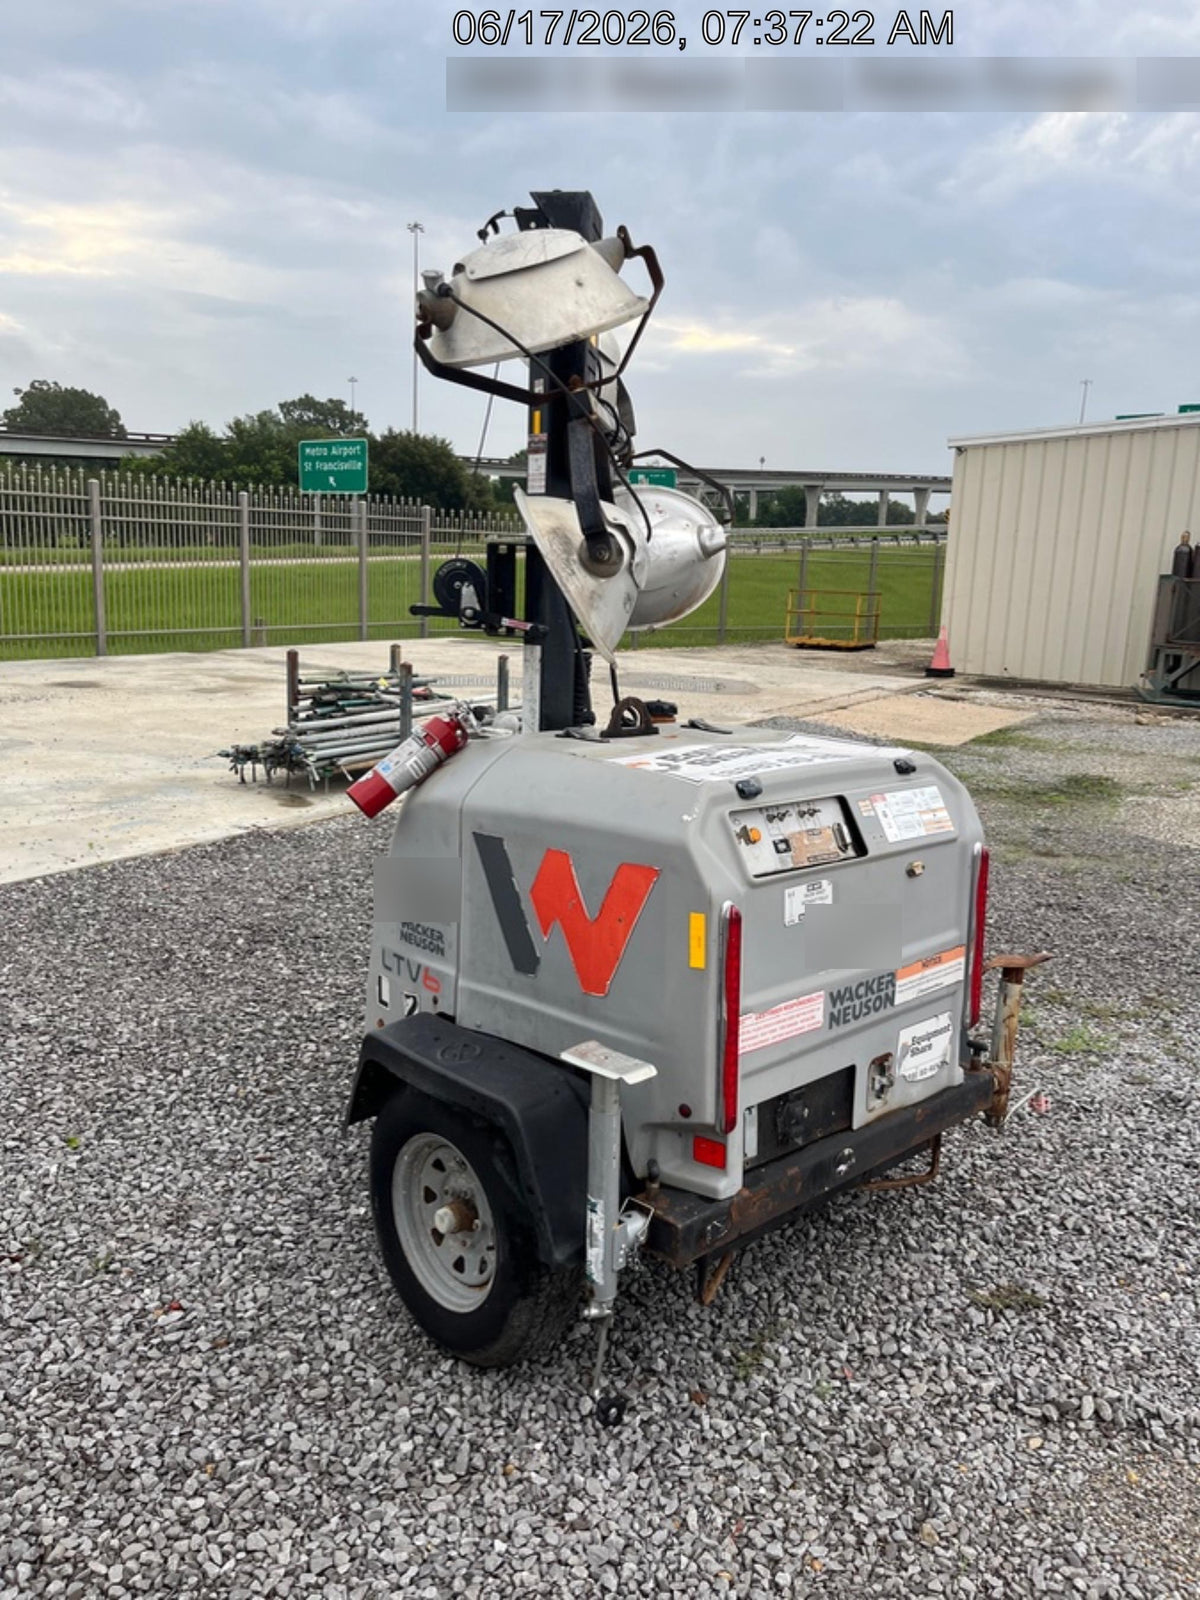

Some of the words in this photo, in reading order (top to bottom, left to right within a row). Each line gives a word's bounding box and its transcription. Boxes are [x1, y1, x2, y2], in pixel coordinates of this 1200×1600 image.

[305, 447, 328, 457] Metro
[331, 445, 362, 458] Airport
[303, 461, 312, 471] St
[315, 460, 363, 471] Francisville
[400, 930, 445, 957] NEUSON
[828, 971, 896, 1010] WACKER
[828, 989, 896, 1030] NEUSON
[911, 1024, 951, 1046] Equipment
[909, 1043, 933, 1057] Share
